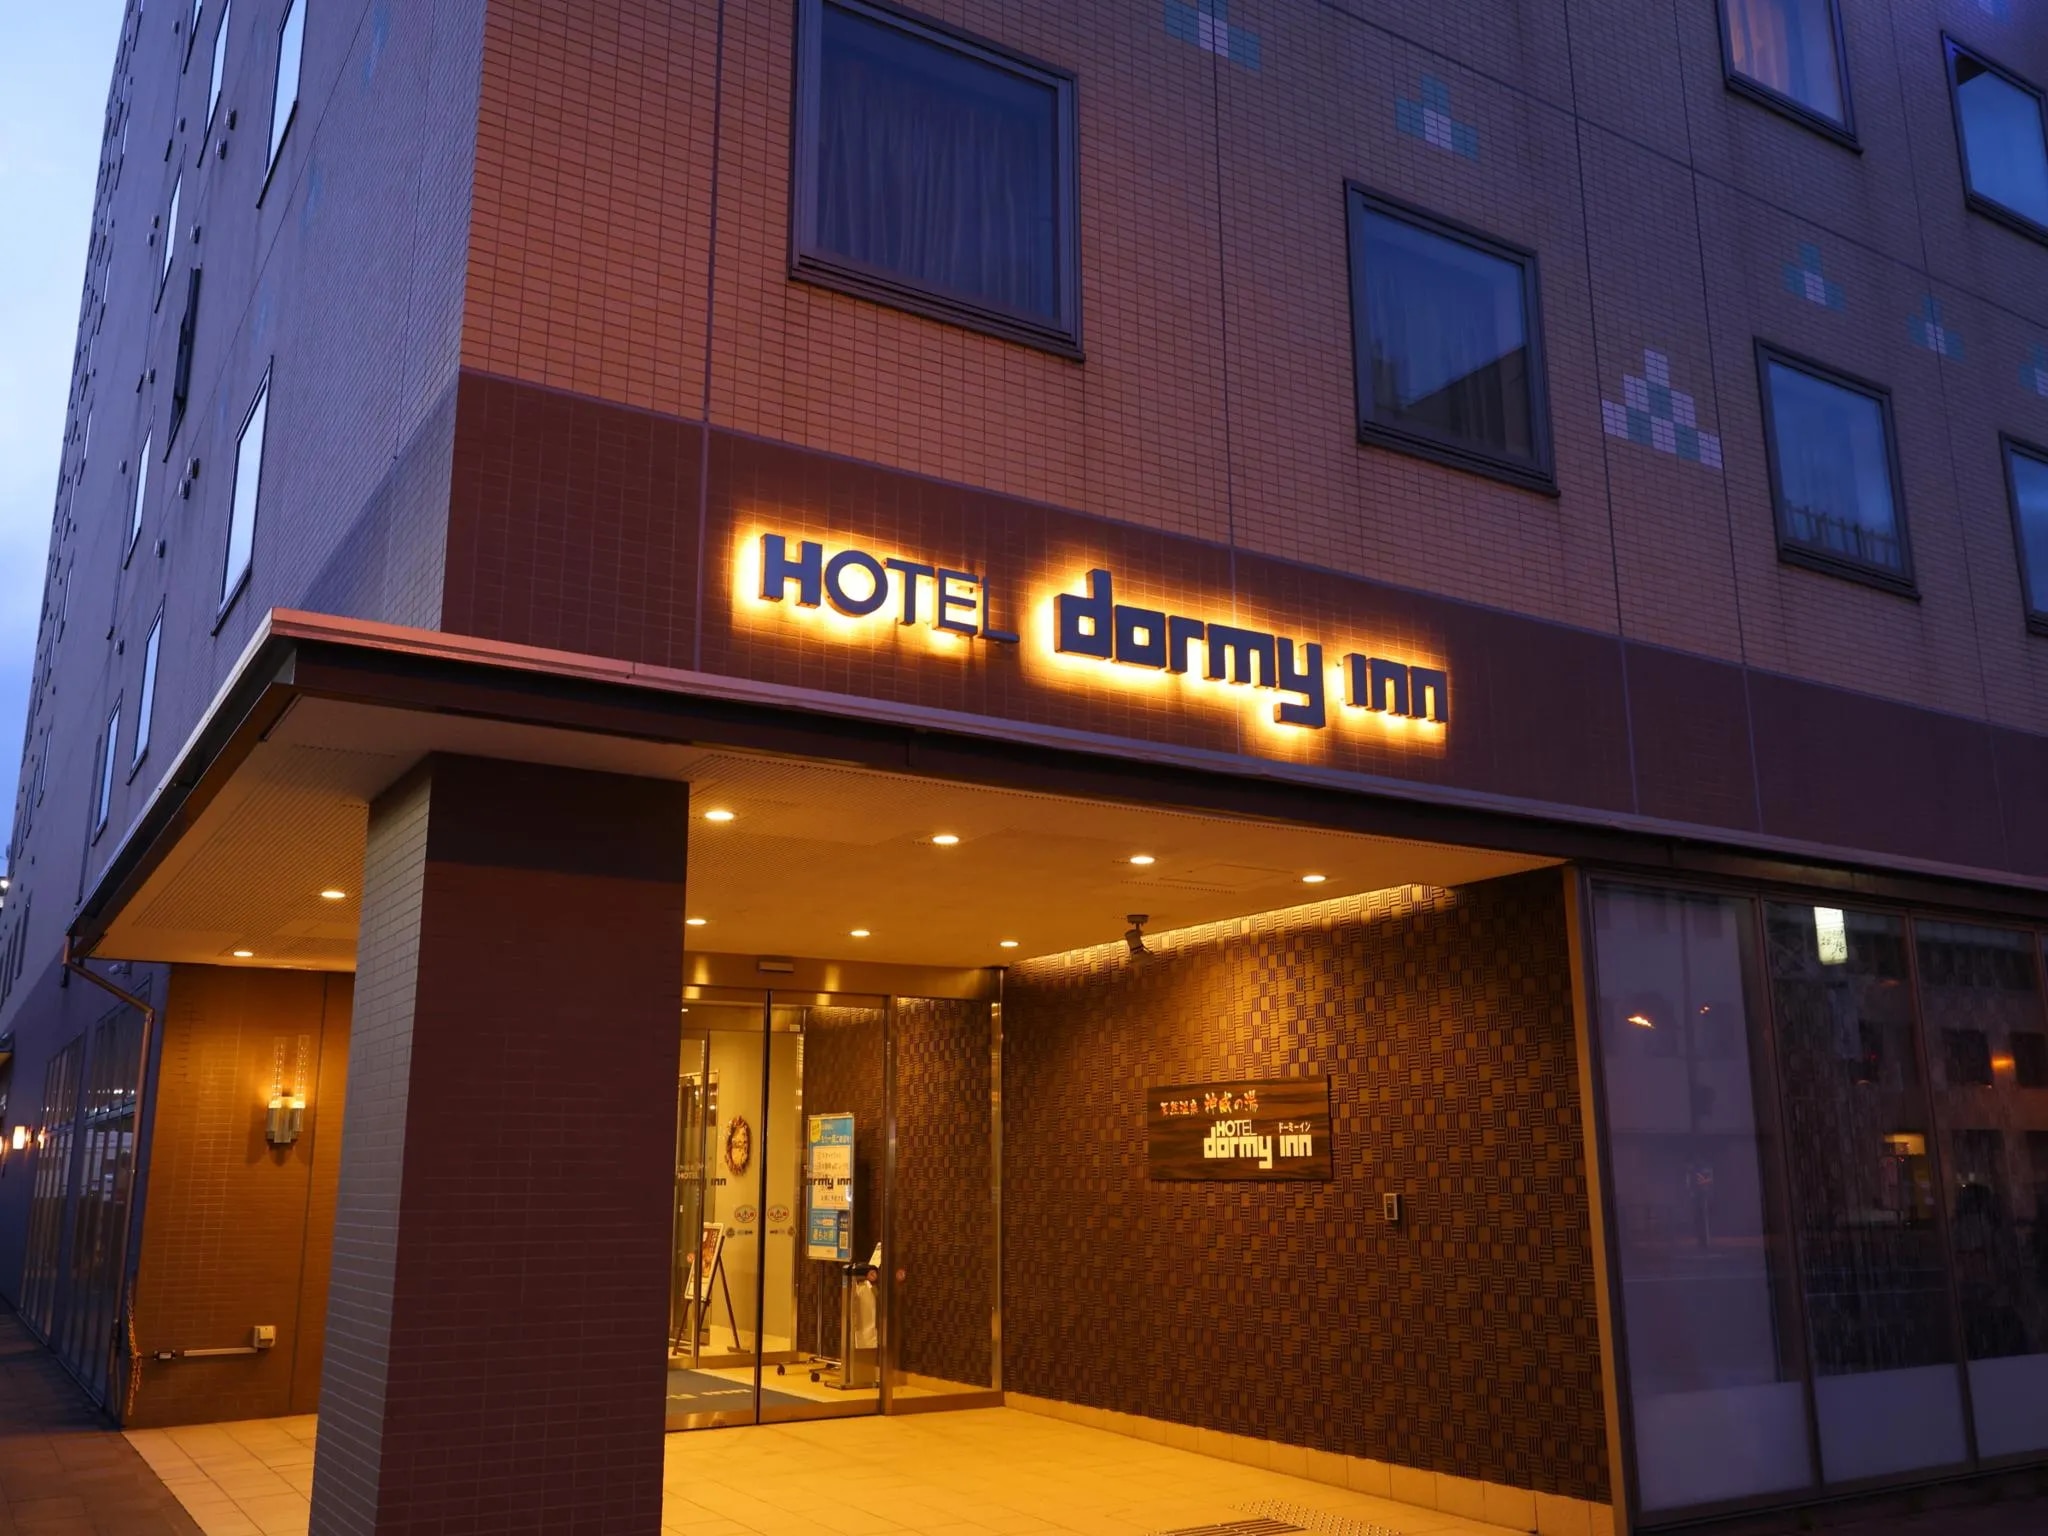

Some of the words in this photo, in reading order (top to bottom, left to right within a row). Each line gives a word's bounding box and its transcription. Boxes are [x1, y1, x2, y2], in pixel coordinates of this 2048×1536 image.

[759, 533, 1019, 643] HOTEL
[1054, 569, 1326, 729] dormy
[1343, 653, 1448, 723] inn
[1160, 1099, 1199, 1115] 天然温泉
[1216, 1119, 1257, 1136] HOTEL
[1279, 1122, 1310, 1134] ドーミーイン
[1204, 1126, 1273, 1169] dormy
[1279, 1135, 1312, 1157] inn
